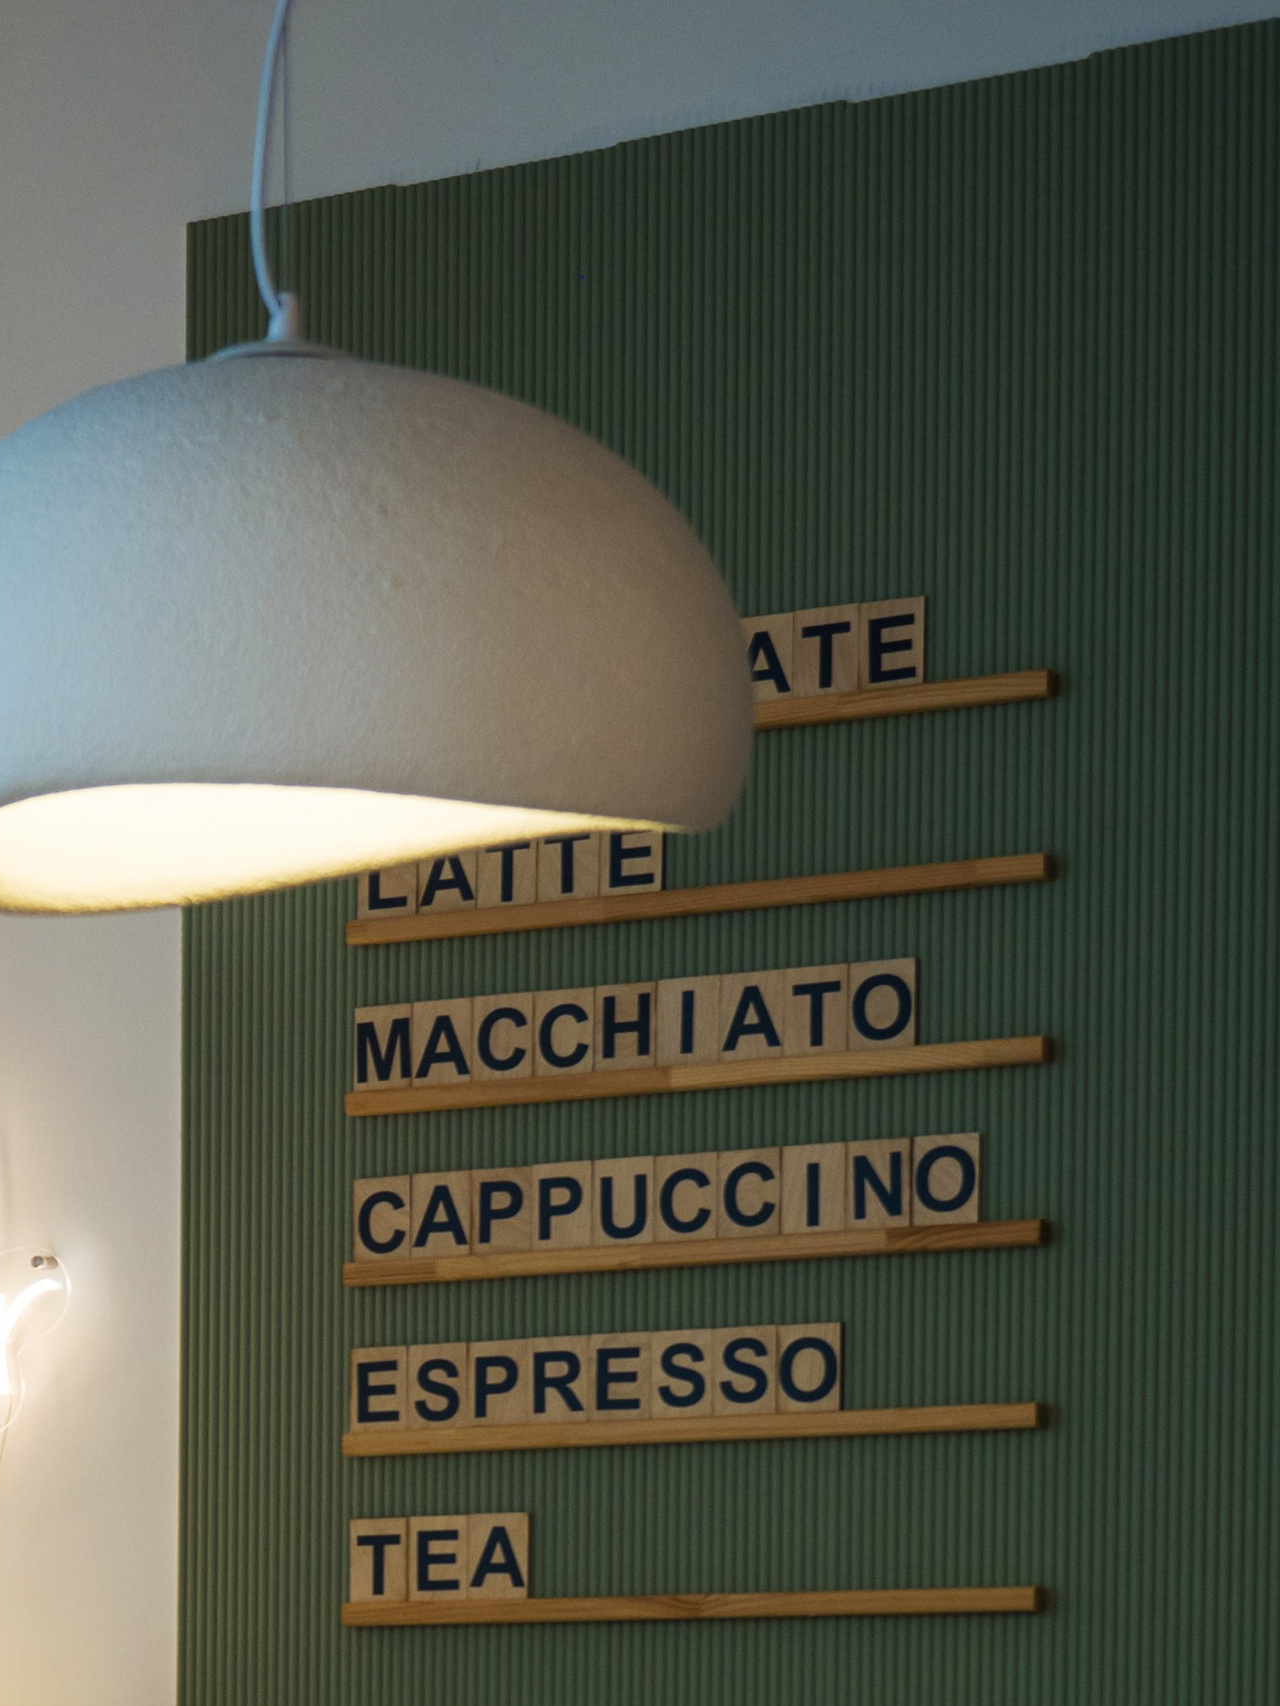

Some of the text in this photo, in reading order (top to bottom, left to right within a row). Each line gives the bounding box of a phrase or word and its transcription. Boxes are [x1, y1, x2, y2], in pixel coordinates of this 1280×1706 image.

[368, 829, 655, 911] LATTE
[356, 973, 913, 1085] MACCHIATO
[357, 1145, 977, 1254] CAPPUCCINO
[356, 1337, 839, 1424] ESPRESSO
[356, 1526, 525, 1596] TEA
